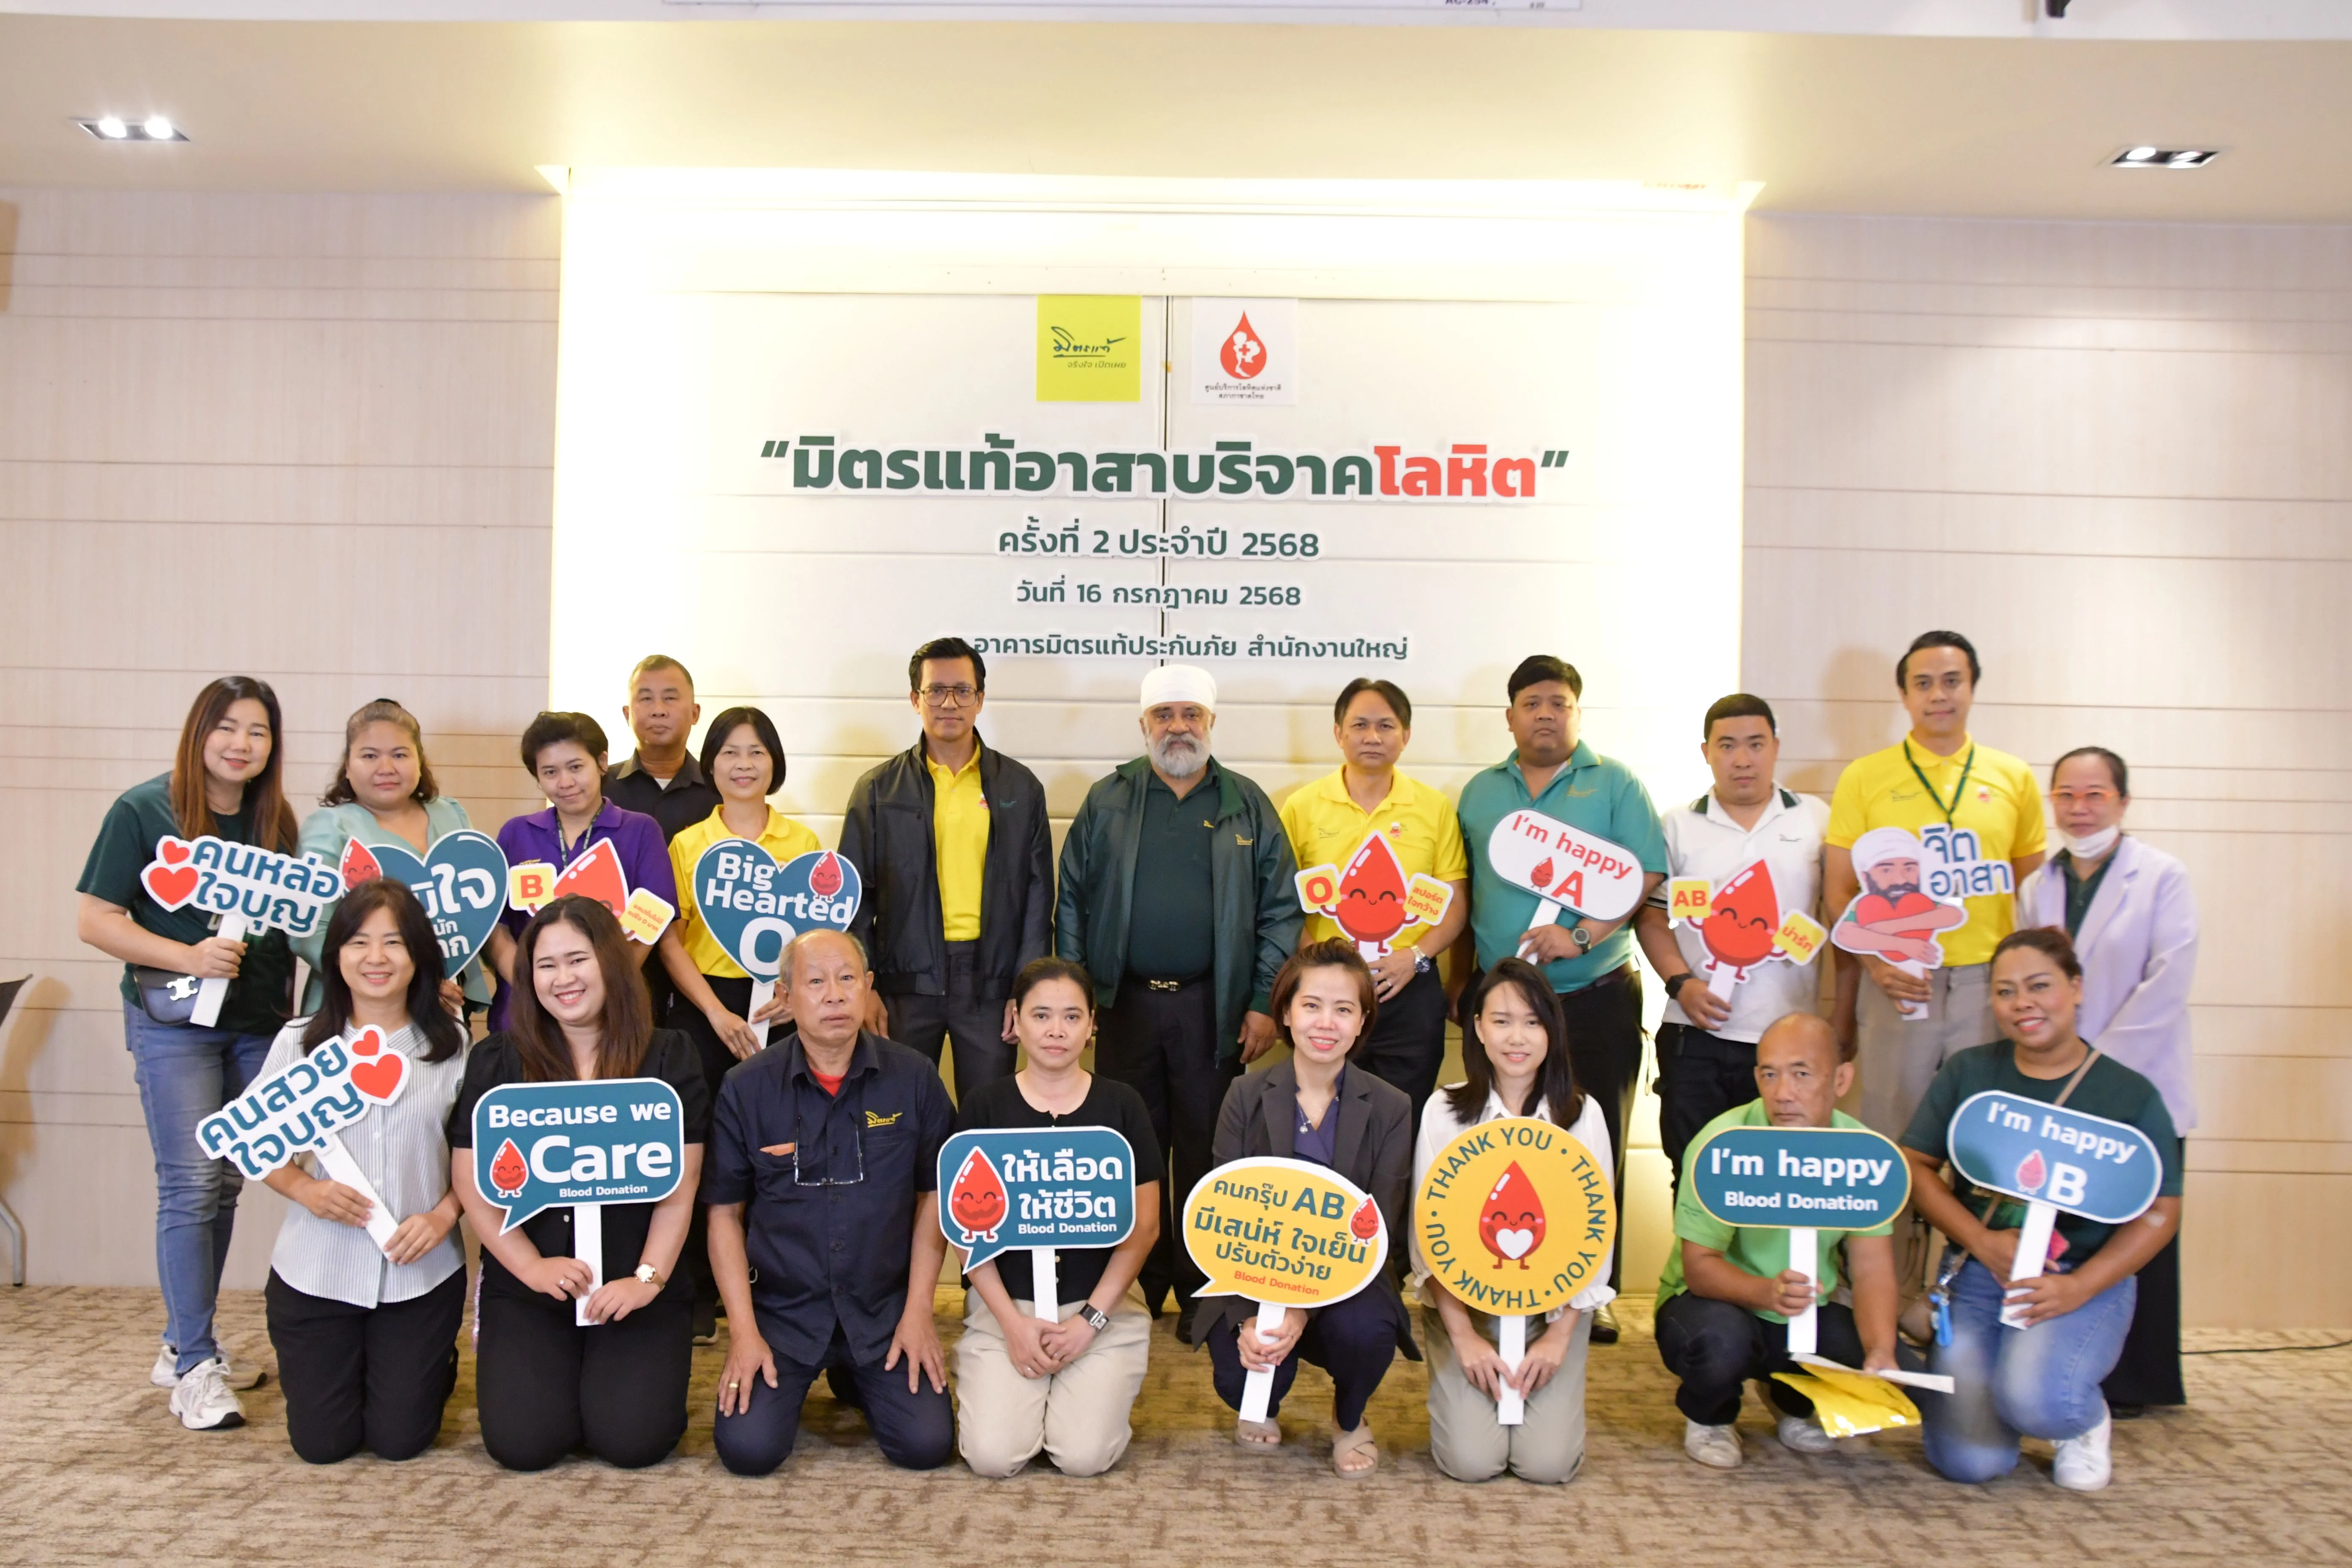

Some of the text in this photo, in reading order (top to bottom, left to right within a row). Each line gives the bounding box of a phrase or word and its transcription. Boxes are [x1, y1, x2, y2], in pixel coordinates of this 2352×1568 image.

[999, 516, 1320, 557] ครั้งที่ 2 ประจำปี 2568
[1017, 575, 1301, 609] วันที่ 16 กรกฎาคม 2568
[973, 632, 1408, 661] อาคารมิตรแท้ประกันภัย สำนักงานใหญ่
[1512, 814, 1633, 880] I'm happy
[1923, 827, 1977, 864] จิต
[192, 841, 339, 898] คนหล่อ
[520, 874, 543, 898] B
[716, 852, 776, 891] Big
[1551, 870, 1584, 908] A
[1930, 863, 2010, 897] อาสา
[196, 871, 318, 932] ใจบุญ
[705, 878, 854, 924] Hearted
[1306, 876, 1333, 904] O
[1673, 890, 1707, 907] AB
[201, 1042, 348, 1153] คนสวย
[489, 1102, 671, 1128] Because we
[230, 1082, 364, 1176] ใจบุญ
[1987, 1102, 2138, 1164] I'm happy
[530, 1135, 672, 1183] Care
[1002, 1148, 1123, 1182] ให้เลือด
[1426, 1127, 1553, 1200] THANK YOU
[1711, 1148, 1892, 1187] I'm happy
[559, 1184, 648, 1198] Blood Donation
[1213, 1179, 1345, 1220] คนกรุ๊ป AB
[1724, 1191, 1879, 1211] Blood Donation
[2046, 1161, 2088, 1206] B
[1018, 1189, 1116, 1220] ให้ชีวิต
[1554, 1155, 1607, 1293] THANK YOU
[1018, 1221, 1117, 1234] Blood Donation
[1194, 1206, 1367, 1263] มีเสน่ห์ ใจเย็น
[1216, 1241, 1332, 1281] ปรับตัวง่าย
[1426, 1224, 1541, 1309] THANK YOU
[1234, 1271, 1319, 1296] Blood Donation
